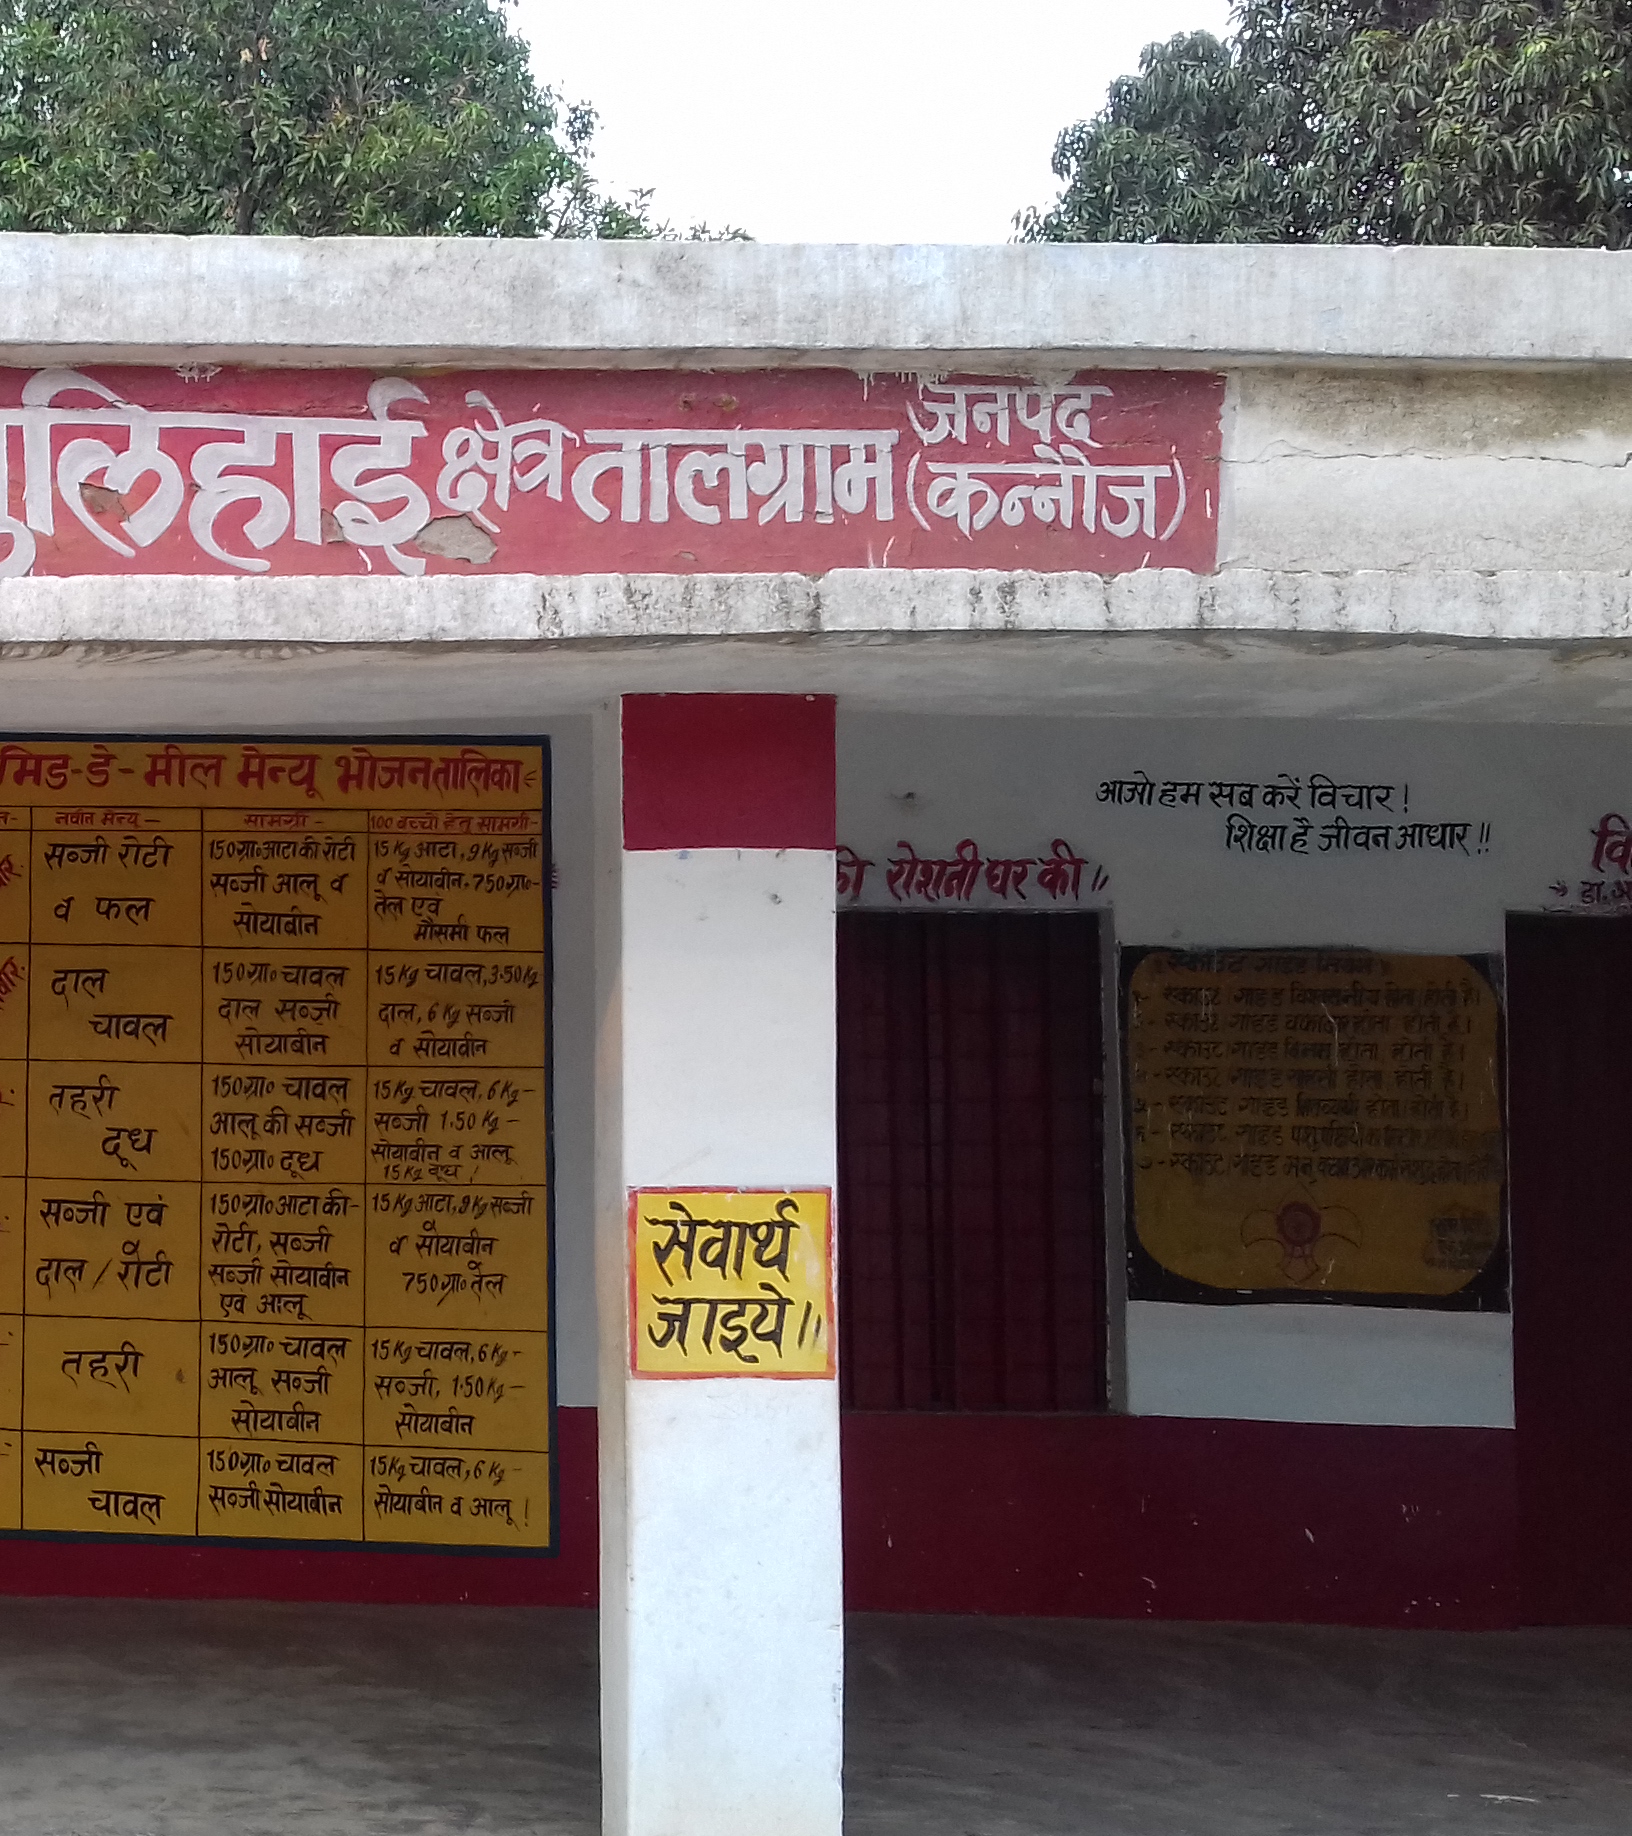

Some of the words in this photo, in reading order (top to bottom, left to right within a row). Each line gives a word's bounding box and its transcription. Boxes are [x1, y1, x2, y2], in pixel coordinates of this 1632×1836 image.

[437, 390, 581, 534] क्षेत्र
[571, 426, 899, 526] तालग्राम
[907, 383, 1115, 448] जनपद
[236, 745, 324, 801] मेन्यू
[1158, 780, 1204, 809] हम
[1208, 781, 1258, 809] सब
[1261, 773, 1303, 810] करें
[1307, 773, 1395, 813] विचार
[44, 835, 111, 870] सब्जी
[118, 835, 175, 868] रोटी
[1225, 812, 1289, 854] शिक्षा
[1289, 814, 1314, 854] है
[1317, 815, 1394, 852] जीवन
[1397, 822, 1472, 856] आधार
[210, 866, 268, 896] सब्जी
[272, 872, 328, 904] आलू
[1037, 837, 1089, 901] की
[95, 896, 156, 926] फल
[233, 901, 323, 938] सोयाबीन
[475, 924, 511, 945] फल
[51, 968, 111, 1009] दाल
[281, 965, 350, 989] चावल
[218, 997, 262, 1025] दाल
[274, 991, 341, 1025] सब्जी
[88, 1013, 175, 1047] चावल
[234, 1026, 330, 1060] सोयाबीन
[49, 1073, 121, 1120] तहरी
[281, 1077, 352, 1105] चावल
[210, 1111, 261, 1141] आलू
[262, 1104, 292, 1137] की
[294, 1108, 357, 1139] सब्जी
[374, 1104, 430, 1134] सब्जी
[101, 1126, 159, 1172] दूध
[279, 1149, 325, 1181] दूध
[39, 1189, 111, 1230] सब्जी
[124, 1194, 169, 1227] एवं
[269, 1225, 334, 1256] सब्जी
[643, 1197, 801, 1288] सेवार्थ
[35, 1258, 89, 1301] दाल
[208, 1257, 266, 1288] सब्जी
[270, 1258, 352, 1291] सोयाबीन
[256, 1292, 314, 1322] आलू
[61, 1340, 145, 1394] तहरी
[279, 1336, 352, 1368] चावल
[207, 1367, 264, 1396] आलू
[272, 1364, 333, 1397] सब्जी
[231, 1399, 322, 1439] सोयाबीन
[395, 1402, 476, 1440] सोयाबीन
[34, 1440, 104, 1477] सब्जी
[275, 1453, 341, 1478] चावल
[87, 1489, 167, 1526] चावल
[208, 1479, 262, 1515] सब्जी
[263, 1481, 344, 1516] सोयाबीन
[373, 1483, 443, 1519] सोयाबीन
[469, 1496, 520, 1532] आलू
